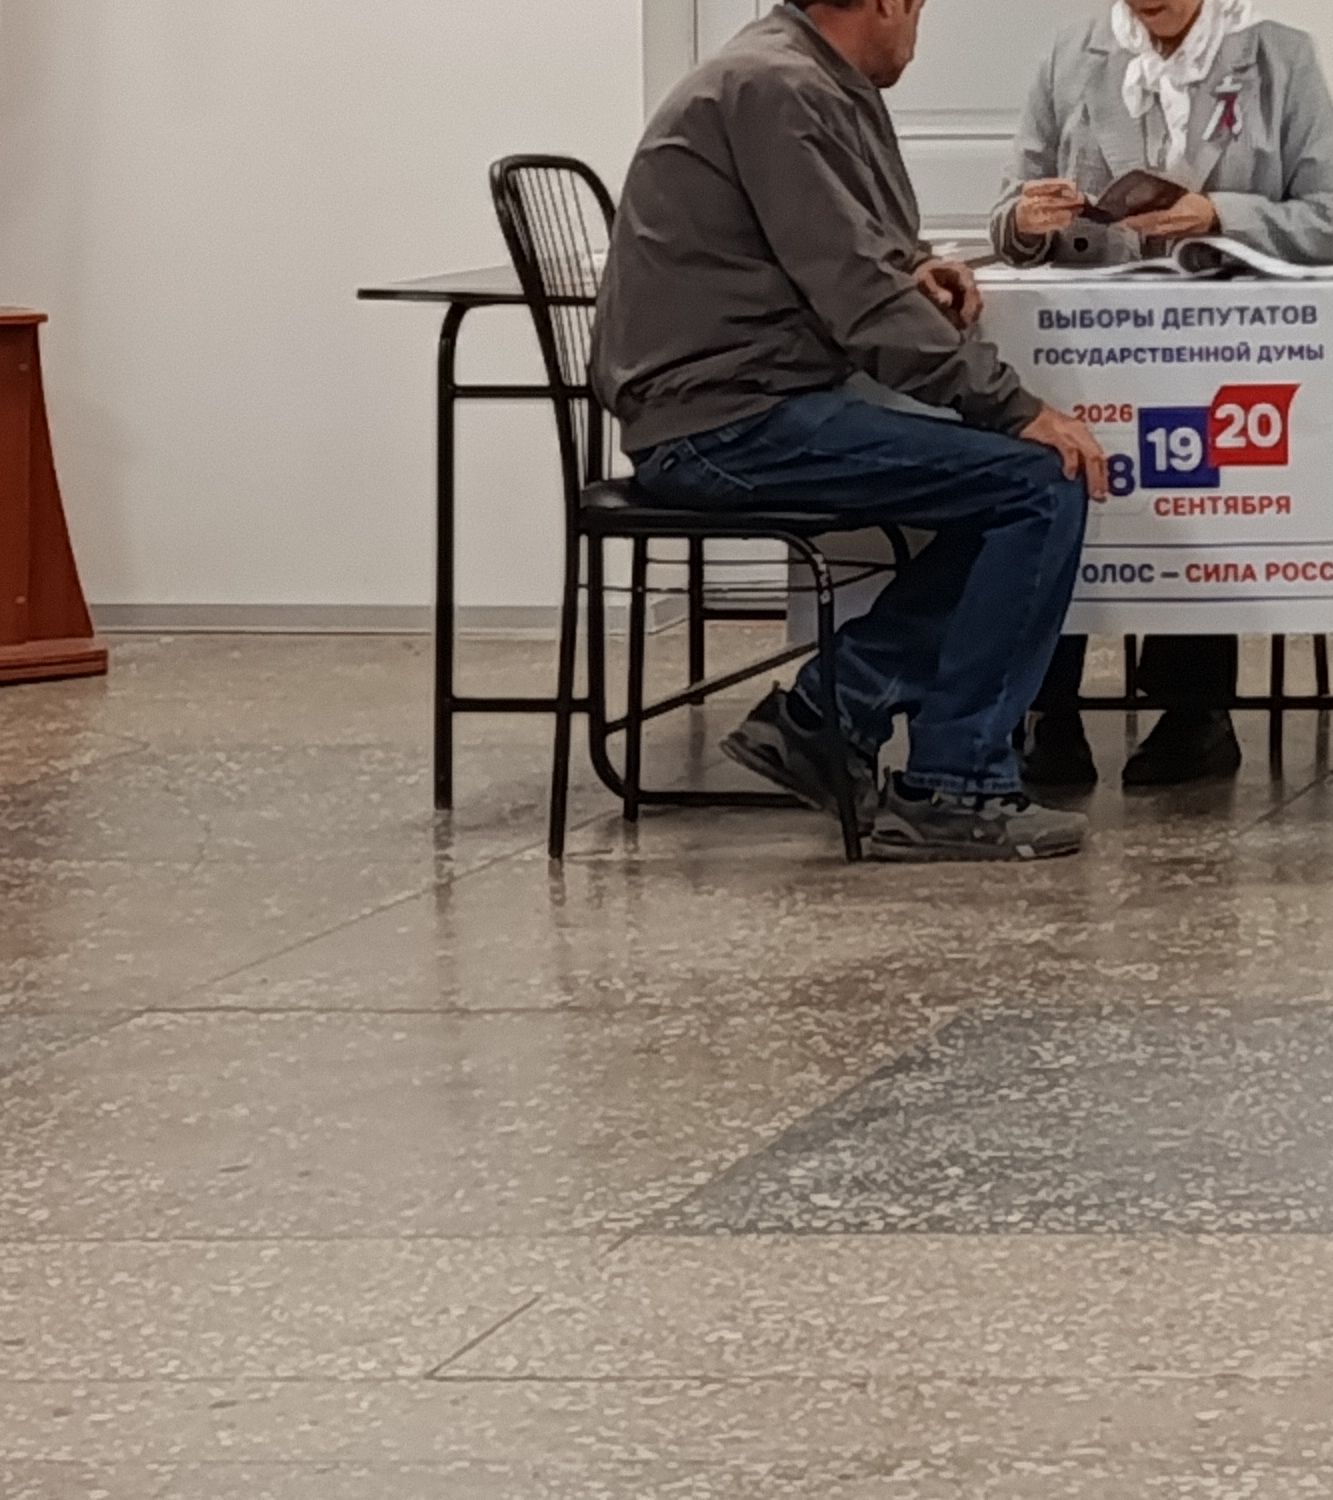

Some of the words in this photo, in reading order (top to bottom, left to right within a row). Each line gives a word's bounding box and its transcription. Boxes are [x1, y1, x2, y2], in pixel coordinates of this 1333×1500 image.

[1038, 309, 1153, 330] ВЫБОРЫ
[1161, 306, 1317, 330] ДЕПУТАТОВ
[1032, 342, 1250, 366] ГОСУДАРСТВЕННОЙ
[1257, 345, 1324, 363] ДУМЫ
[1109, 454, 1136, 498] 8
[1146, 428, 1204, 472] 19
[1214, 404, 1282, 449] 20
[1154, 496, 1290, 517] СЕНТЯБРЯ
[1082, 562, 1155, 584] ОЛОС
[1185, 563, 1256, 583] СИЛА
